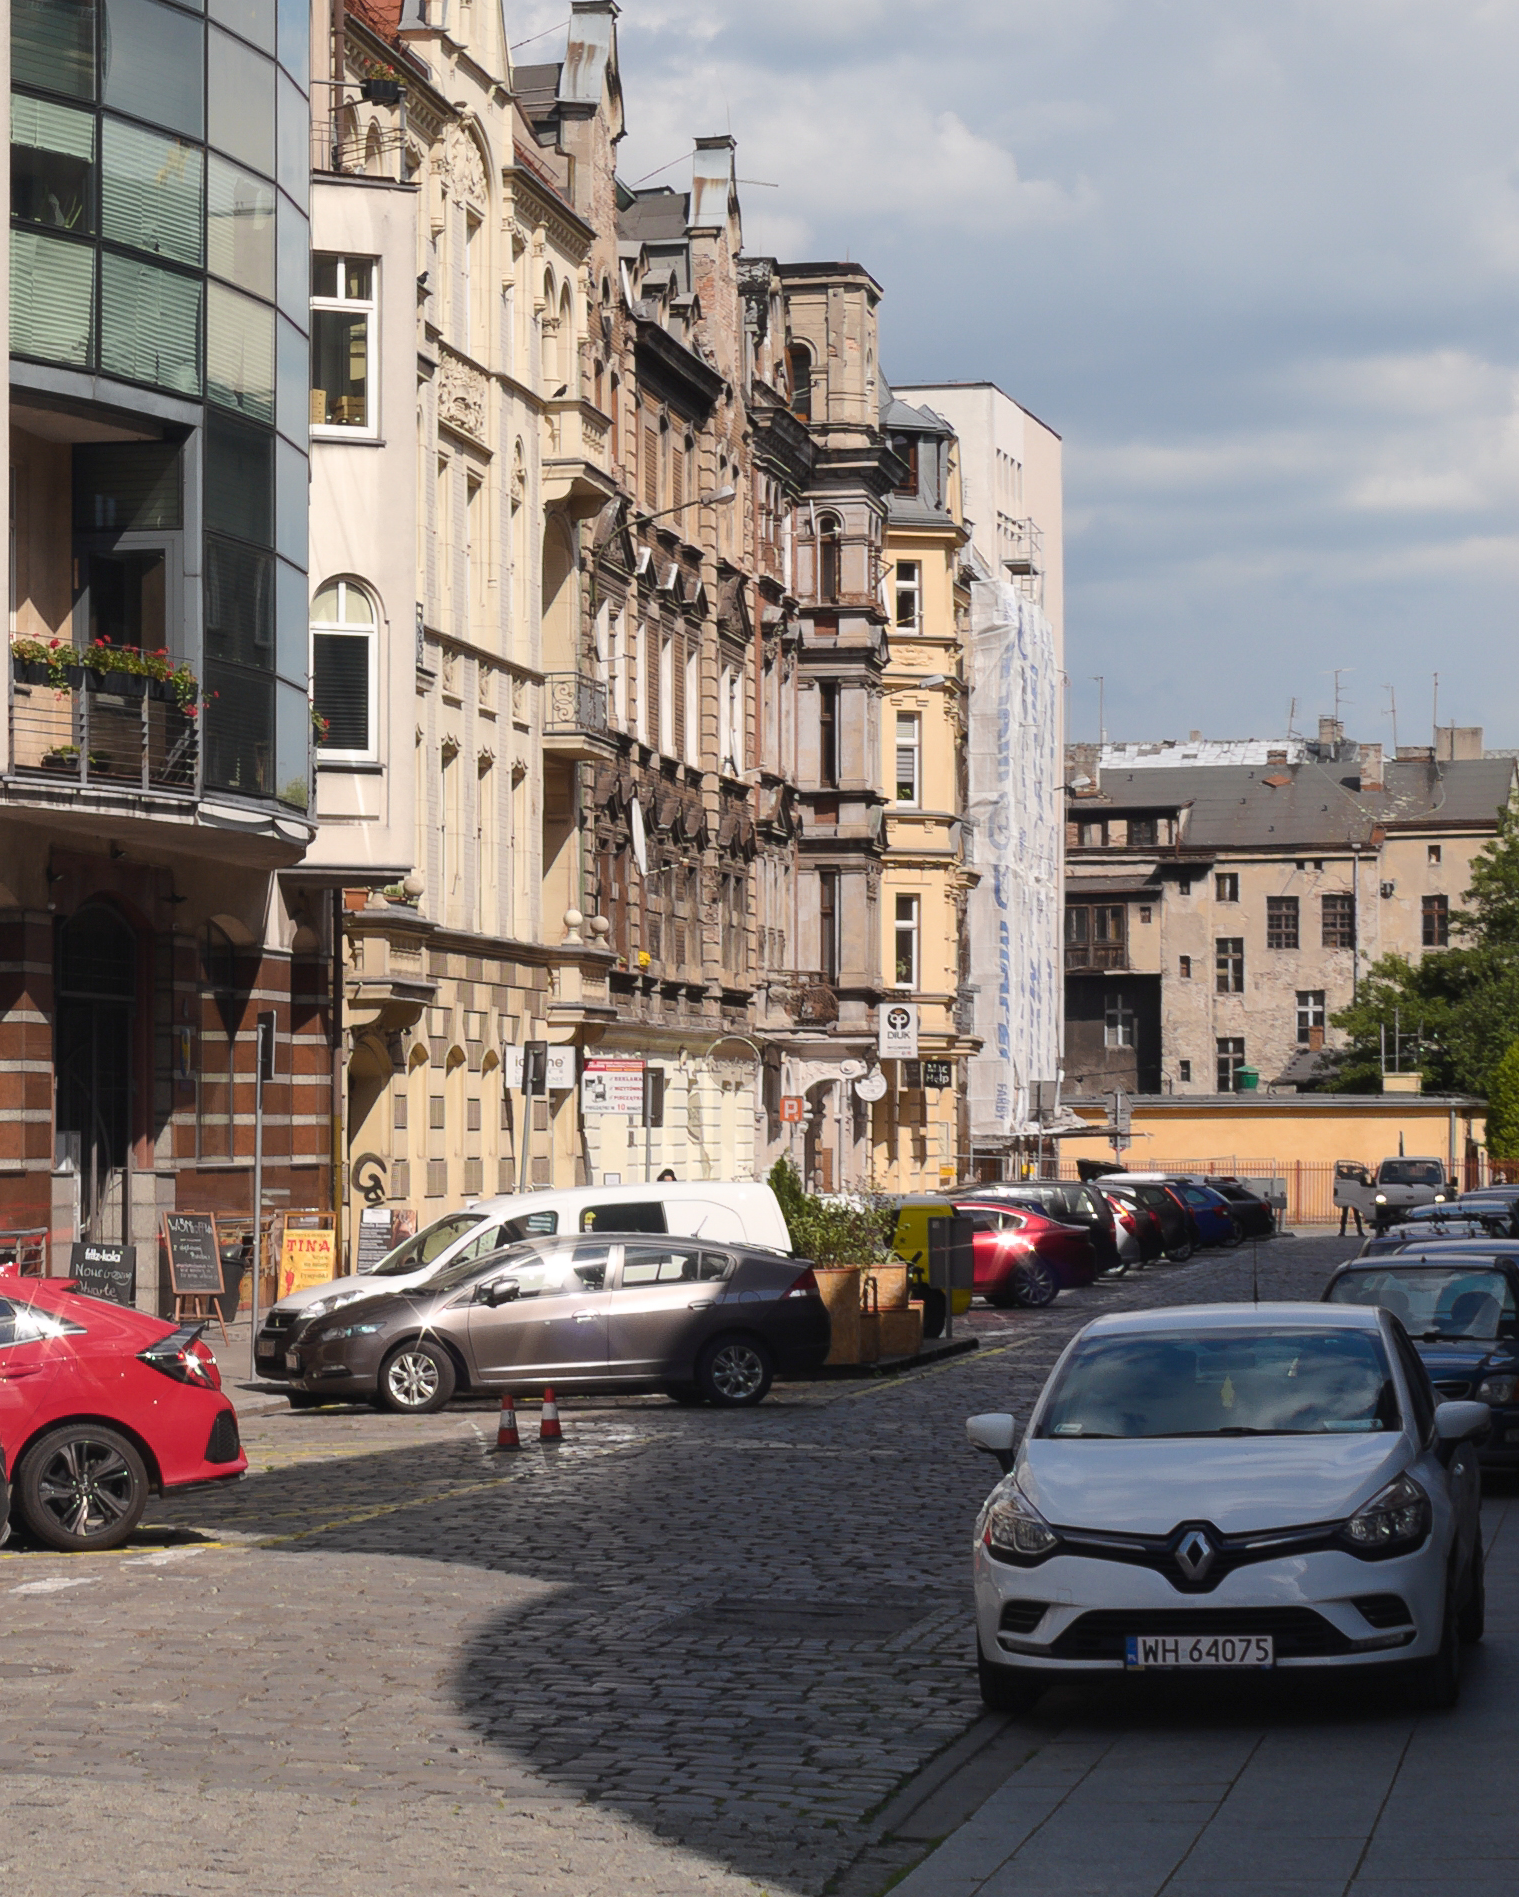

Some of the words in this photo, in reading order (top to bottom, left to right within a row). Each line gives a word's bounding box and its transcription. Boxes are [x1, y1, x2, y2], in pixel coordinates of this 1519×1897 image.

[887, 1031, 910, 1040] DIUK
[926, 1073, 949, 1084] Help
[617, 1103, 626, 1111] 10
[995, 1083, 1009, 1120] FARBY
[784, 1100, 799, 1120] P
[286, 1239, 331, 1252] TINA
[1142, 1638, 1179, 1663] WH
[1189, 1638, 1270, 1663] 64075
